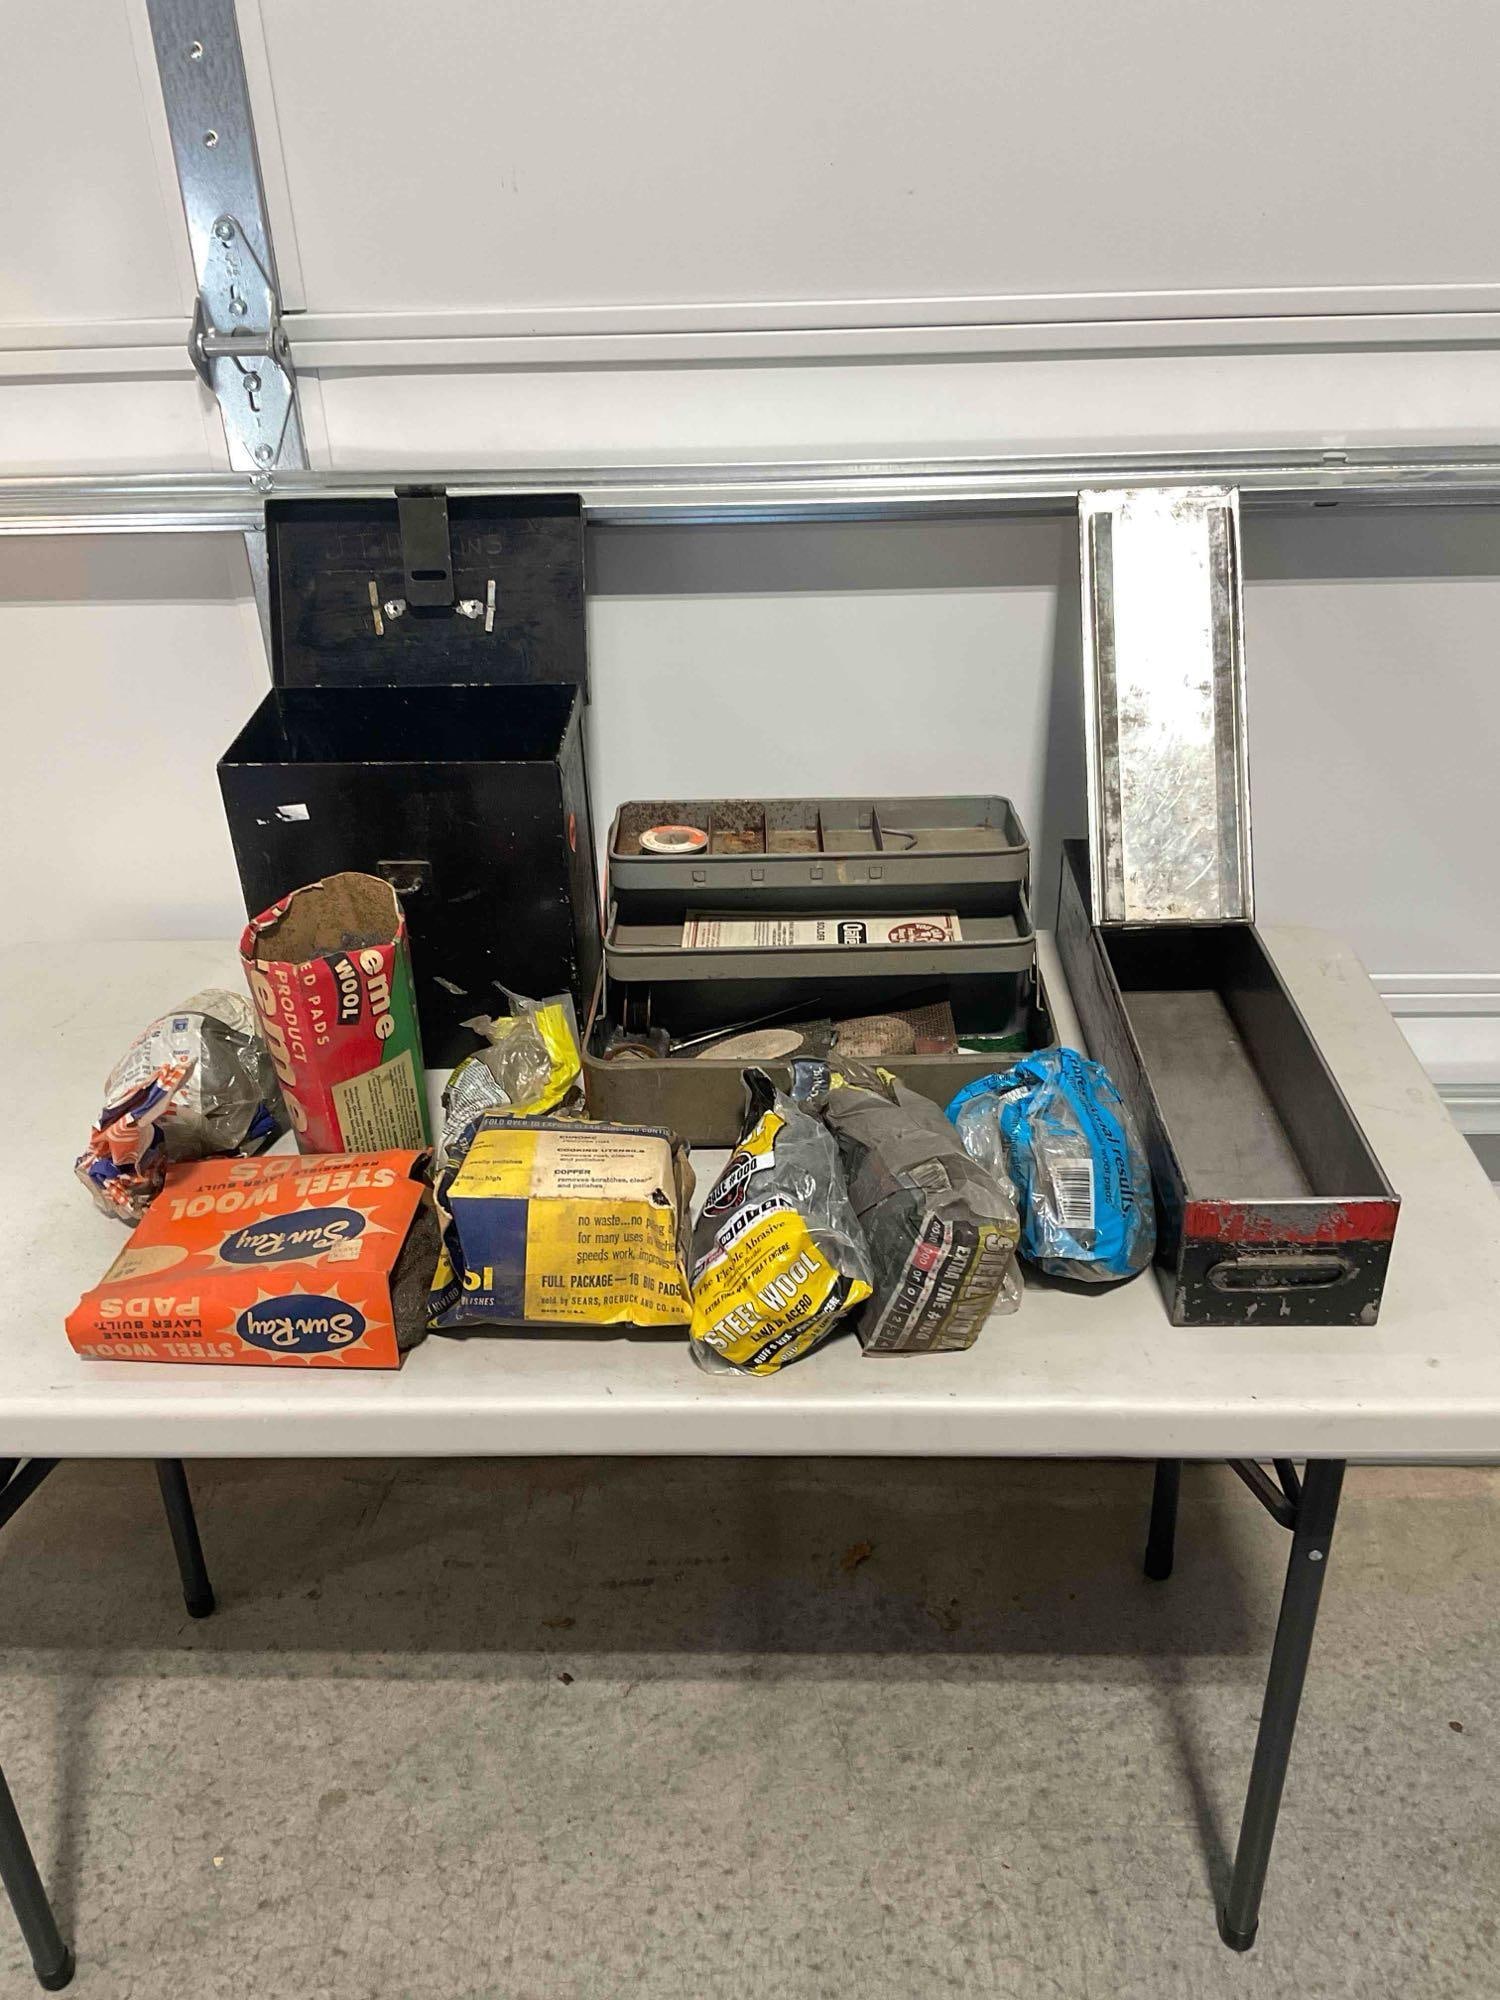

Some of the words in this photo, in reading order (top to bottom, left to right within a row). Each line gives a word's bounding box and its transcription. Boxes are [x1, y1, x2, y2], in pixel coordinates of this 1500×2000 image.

[334, 958, 360, 1019] WOOL
[360, 949, 395, 1040] eme
[274, 969, 308, 1063] PRODUCT
[308, 995, 330, 1046] PADS
[242, 1172, 286, 1188] LAYER
[292, 1160, 381, 1176] REVERSIBLE
[294, 1167, 397, 1197] STEEL
[195, 1180, 237, 1193] BUILT
[1111, 1147, 1135, 1219] results.
[169, 1183, 279, 1222] WOOL
[286, 1219, 351, 1250] Sun
[578, 1215, 590, 1226] no
[235, 1228, 286, 1257] Ray
[577, 1231, 591, 1244] for
[595, 1233, 620, 1245] many
[623, 1232, 644, 1242] uses
[743, 1219, 785, 1253] Abrasive
[576, 1248, 609, 1264] speeds
[612, 1248, 635, 1261] work,
[944, 1245, 972, 1280] EXTRA
[964, 1233, 1016, 1299] STEEL
[541, 1275, 565, 1288] FULL
[643, 1275, 655, 1291] BIG
[658, 1281, 682, 1297] PADS
[756, 1249, 822, 1313] WOOL
[932, 1281, 956, 1310] FINE
[100, 1296, 201, 1320] PADS
[570, 1296, 600, 1308] SEARS,
[603, 1294, 639, 1306] ROEBUCK
[640, 1298, 654, 1309] AND
[656, 1302, 670, 1313] CO.
[704, 1299, 721, 1316] EXTRA
[785, 1292, 813, 1324] ACERO
[103, 1329, 203, 1340] REVERSIBLE
[151, 1318, 203, 1330] LAYER
[247, 1311, 300, 1346] Ray
[294, 1312, 355, 1345] Sun
[80, 1342, 159, 1357] WOOL
[162, 1342, 236, 1358] STEEL
[752, 1347, 772, 1365] BUFF
